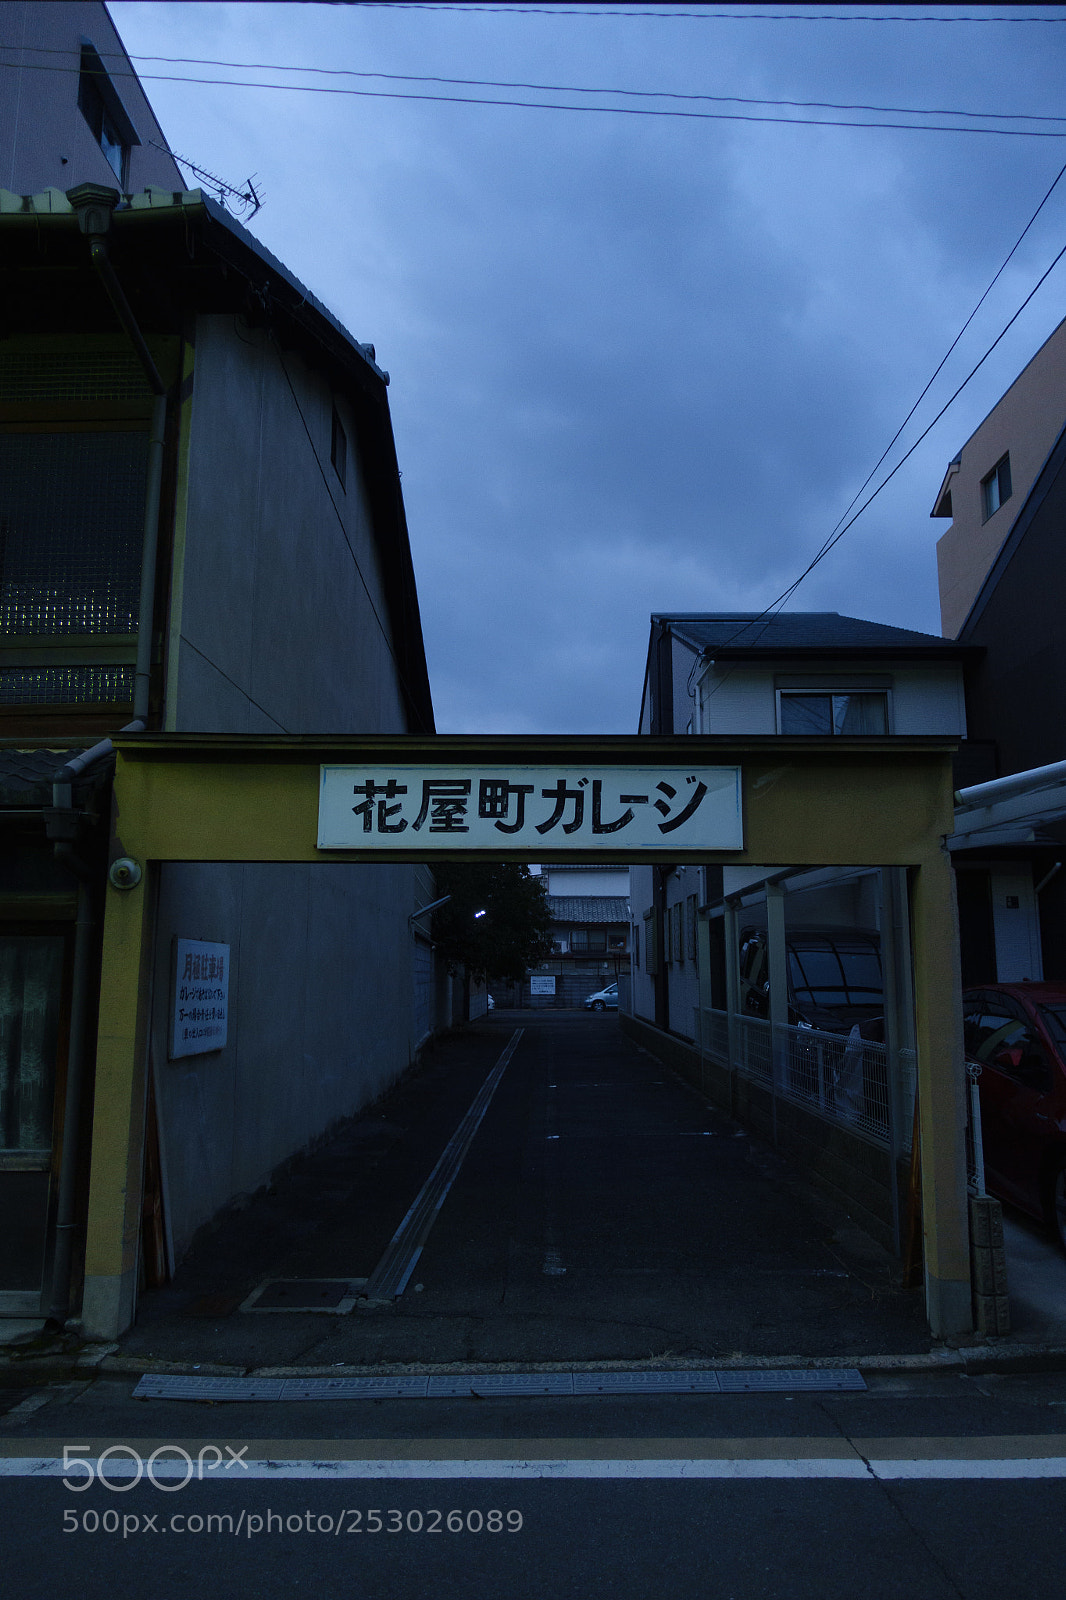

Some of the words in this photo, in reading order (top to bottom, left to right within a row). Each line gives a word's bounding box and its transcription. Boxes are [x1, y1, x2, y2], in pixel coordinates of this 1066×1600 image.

[352, 775, 708, 835] 花屋町ガレージ
